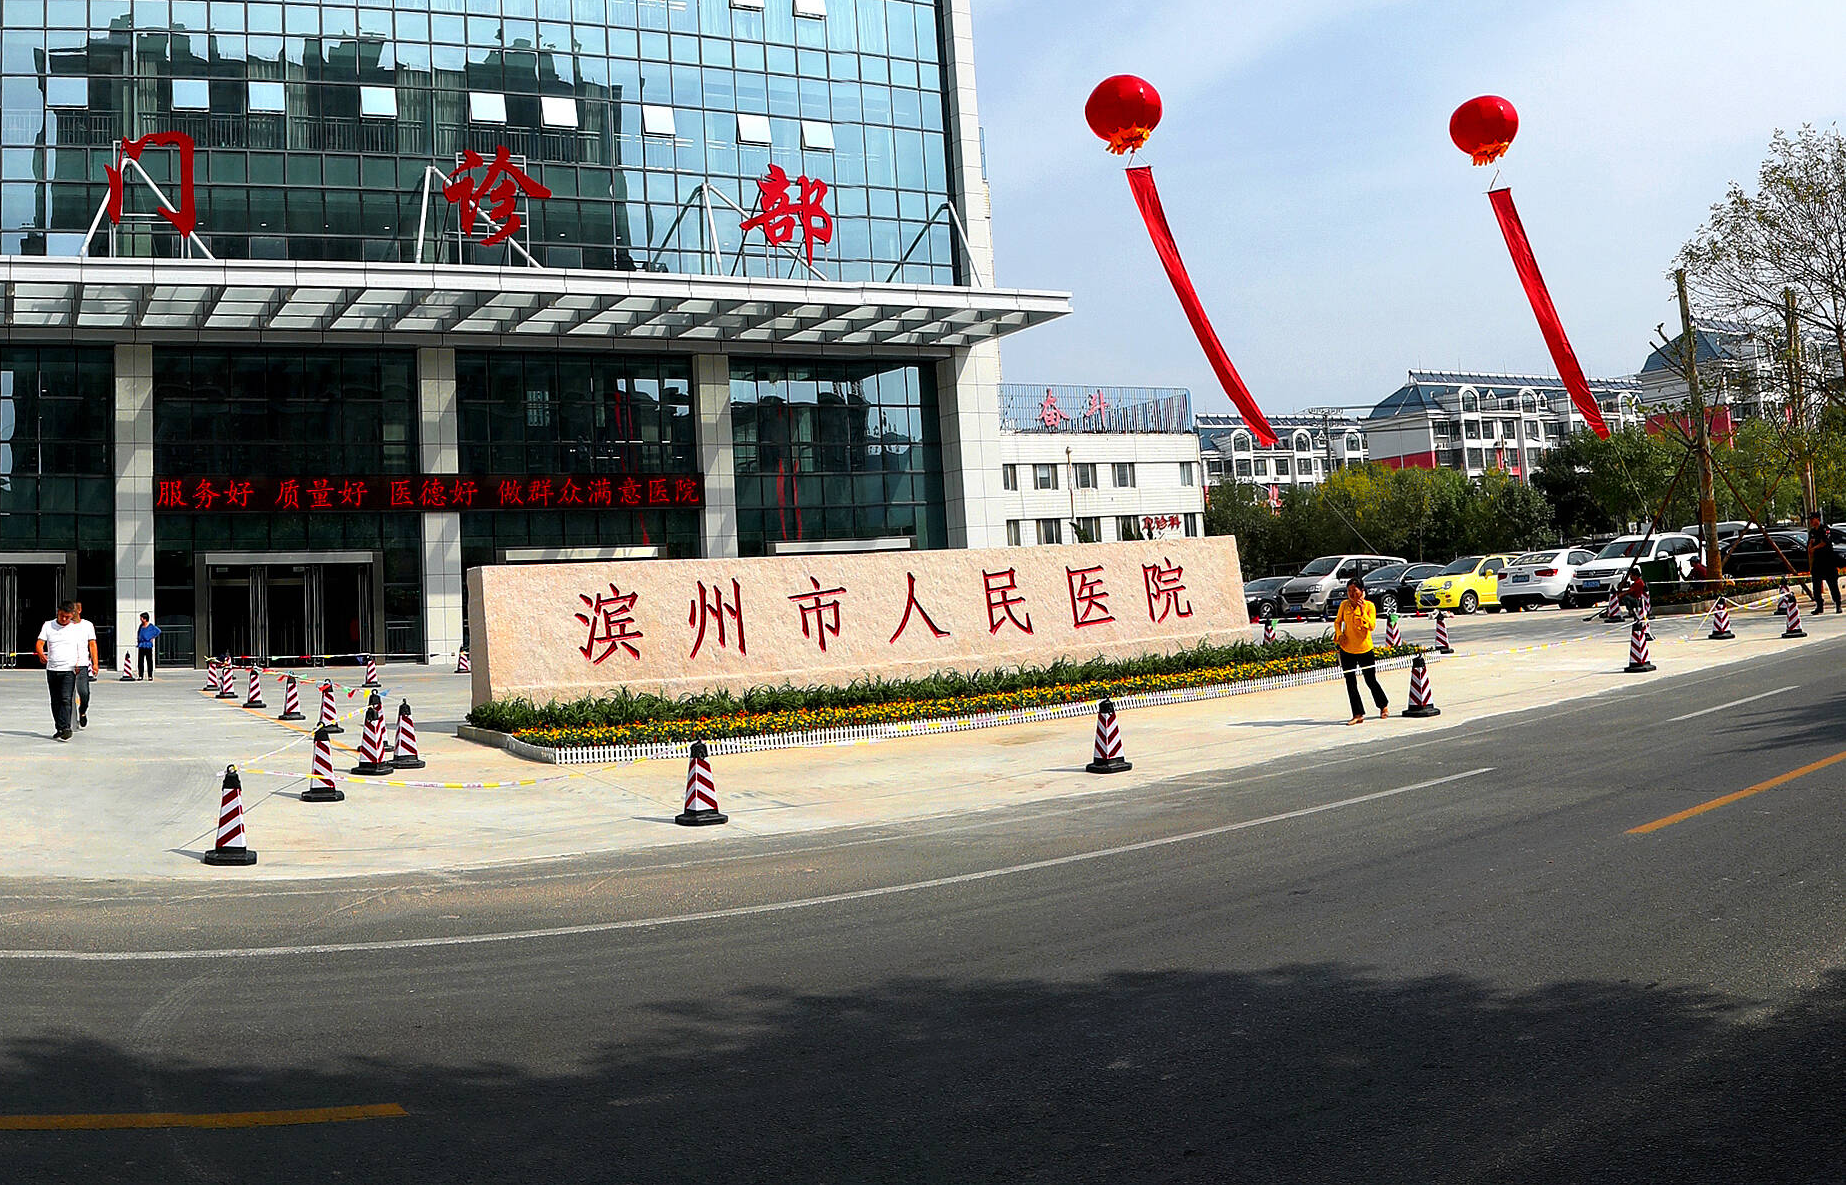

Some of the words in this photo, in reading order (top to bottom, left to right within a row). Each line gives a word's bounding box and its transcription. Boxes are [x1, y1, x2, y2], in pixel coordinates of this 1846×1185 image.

[104, 131, 833, 266] 门诊部
[1037, 388, 1110, 429] 奋斗
[156, 478, 254, 509] 服务好
[274, 478, 369, 509] 质量好
[390, 478, 478, 507] 医德好
[499, 477, 699, 507] 做群众满意医院
[574, 556, 1193, 667] 滨州市人民医院
